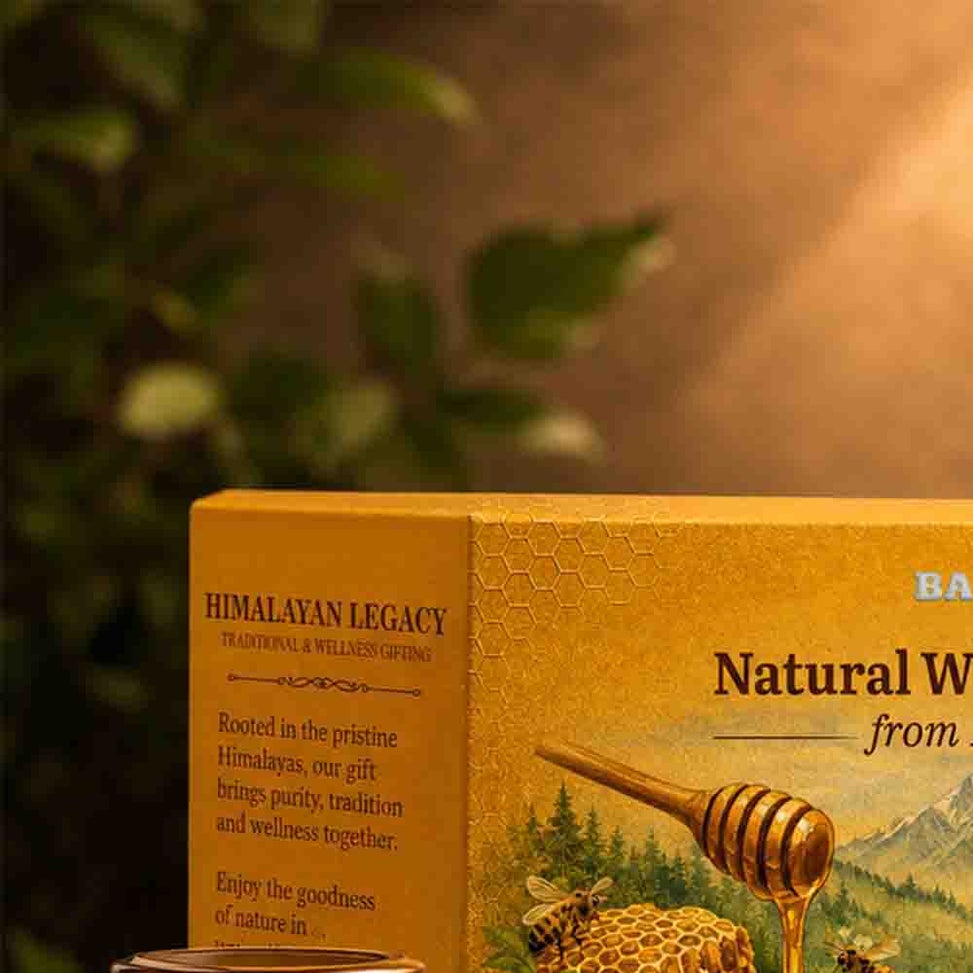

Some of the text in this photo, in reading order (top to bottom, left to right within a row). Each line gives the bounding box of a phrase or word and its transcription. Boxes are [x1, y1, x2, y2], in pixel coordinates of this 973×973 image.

[204, 592, 447, 636] HIMALAYAN LEGACY
[303, 638, 312, 652] &
[314, 638, 377, 658] WELLNESS
[380, 643, 432, 662] GIFTING
[714, 648, 909, 697] Natural
[218, 712, 398, 752] Rooted in the pristine
[865, 713, 959, 753] from
[218, 746, 376, 784] Himalayas, our gift
[217, 778, 403, 818] brings purity, tradition
[217, 814, 398, 851] and wellness together.
[217, 872, 375, 910] Enjoy the goodness
[215, 905, 306, 936] of nature in
